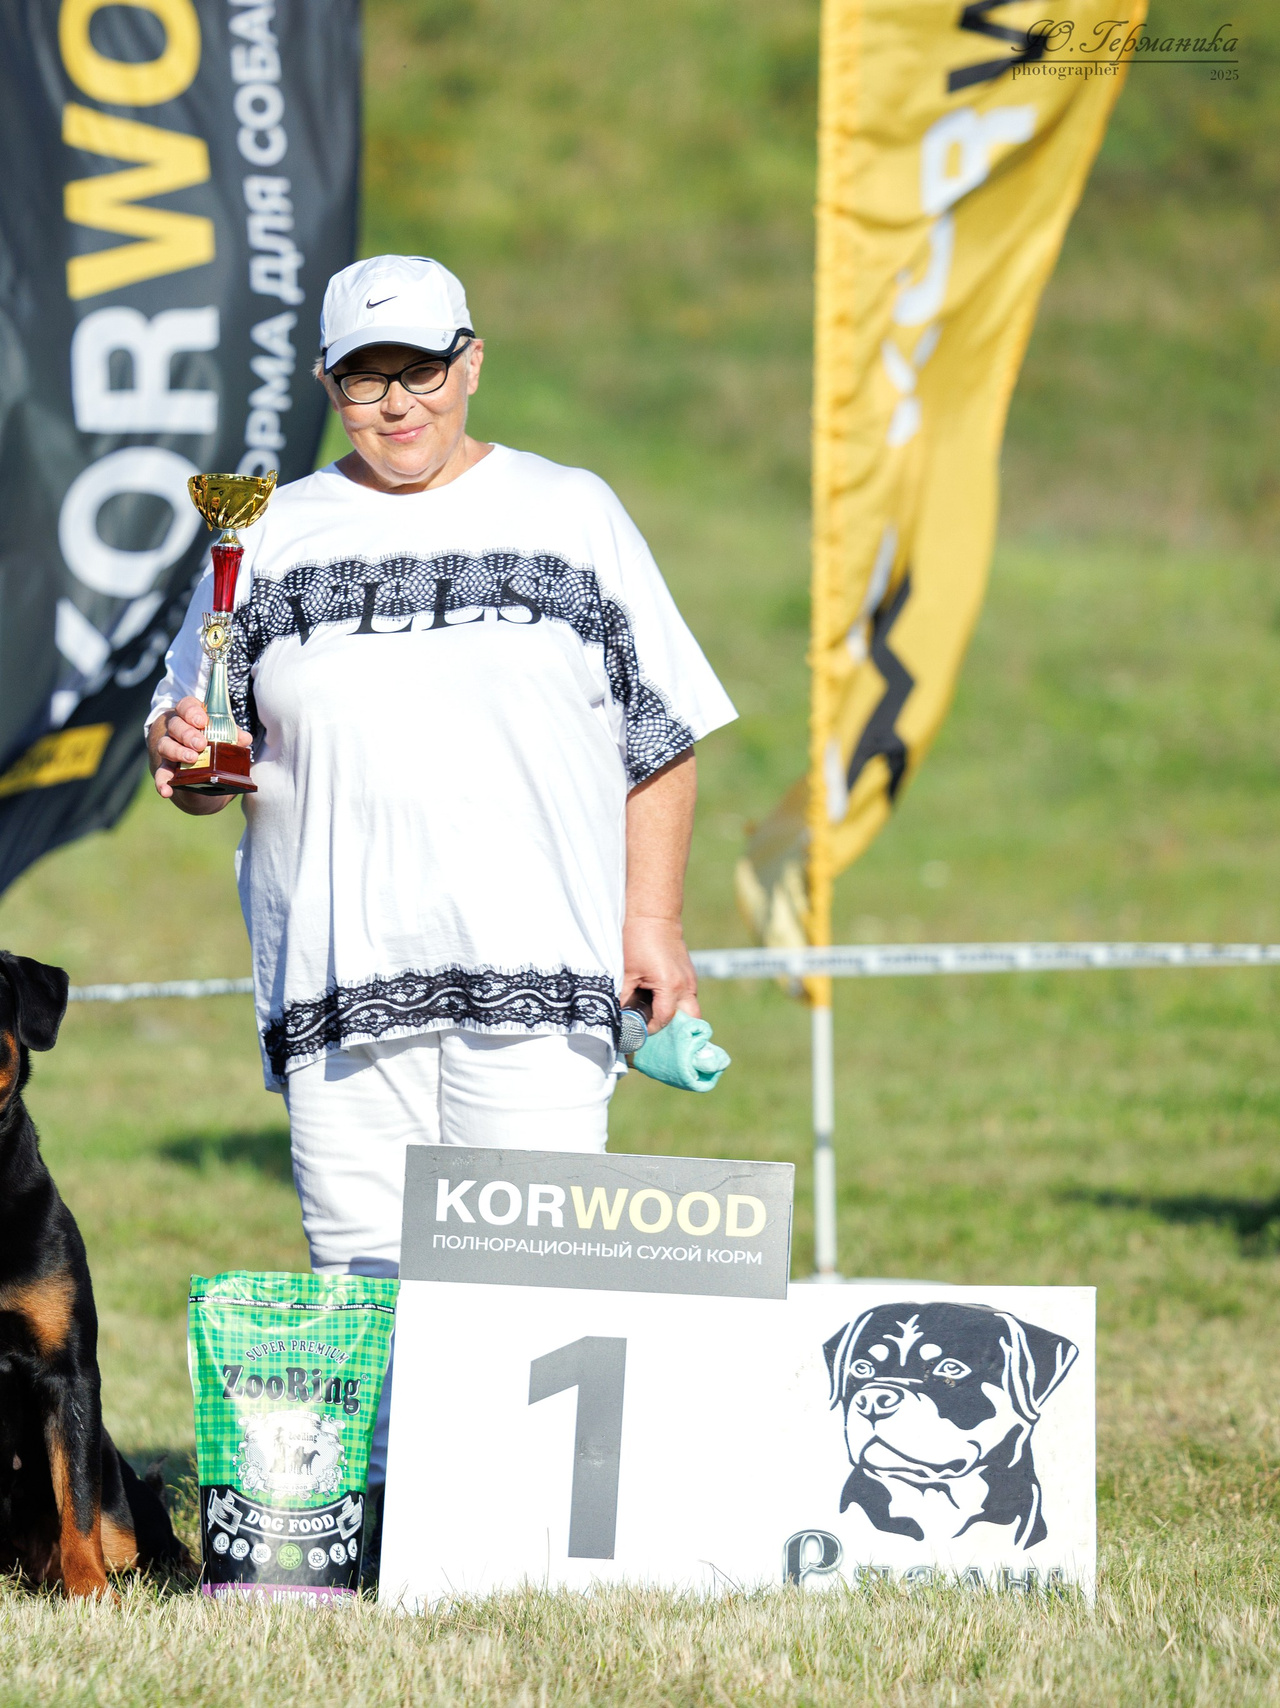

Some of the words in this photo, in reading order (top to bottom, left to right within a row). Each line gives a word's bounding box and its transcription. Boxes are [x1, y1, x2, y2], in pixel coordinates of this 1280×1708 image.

[227, 0, 288, 166] СОБА
[243, 174, 305, 305] ДЛЯ
[234, 310, 298, 479] ОРМА
[432, 1234, 632, 1259] ПОЛНОРАЦИОННЫЙ
[636, 1243, 701, 1262] СУХОЙ
[706, 1250, 763, 1265] КОРМ
[435, 1178, 767, 1238] KORWOOD
[245, 1340, 286, 1361] SUPER
[290, 1339, 350, 1365] PREMIUM
[528, 1335, 627, 1560] 1
[244, 1509, 285, 1532] DOG
[288, 1513, 336, 1533] FOOD
